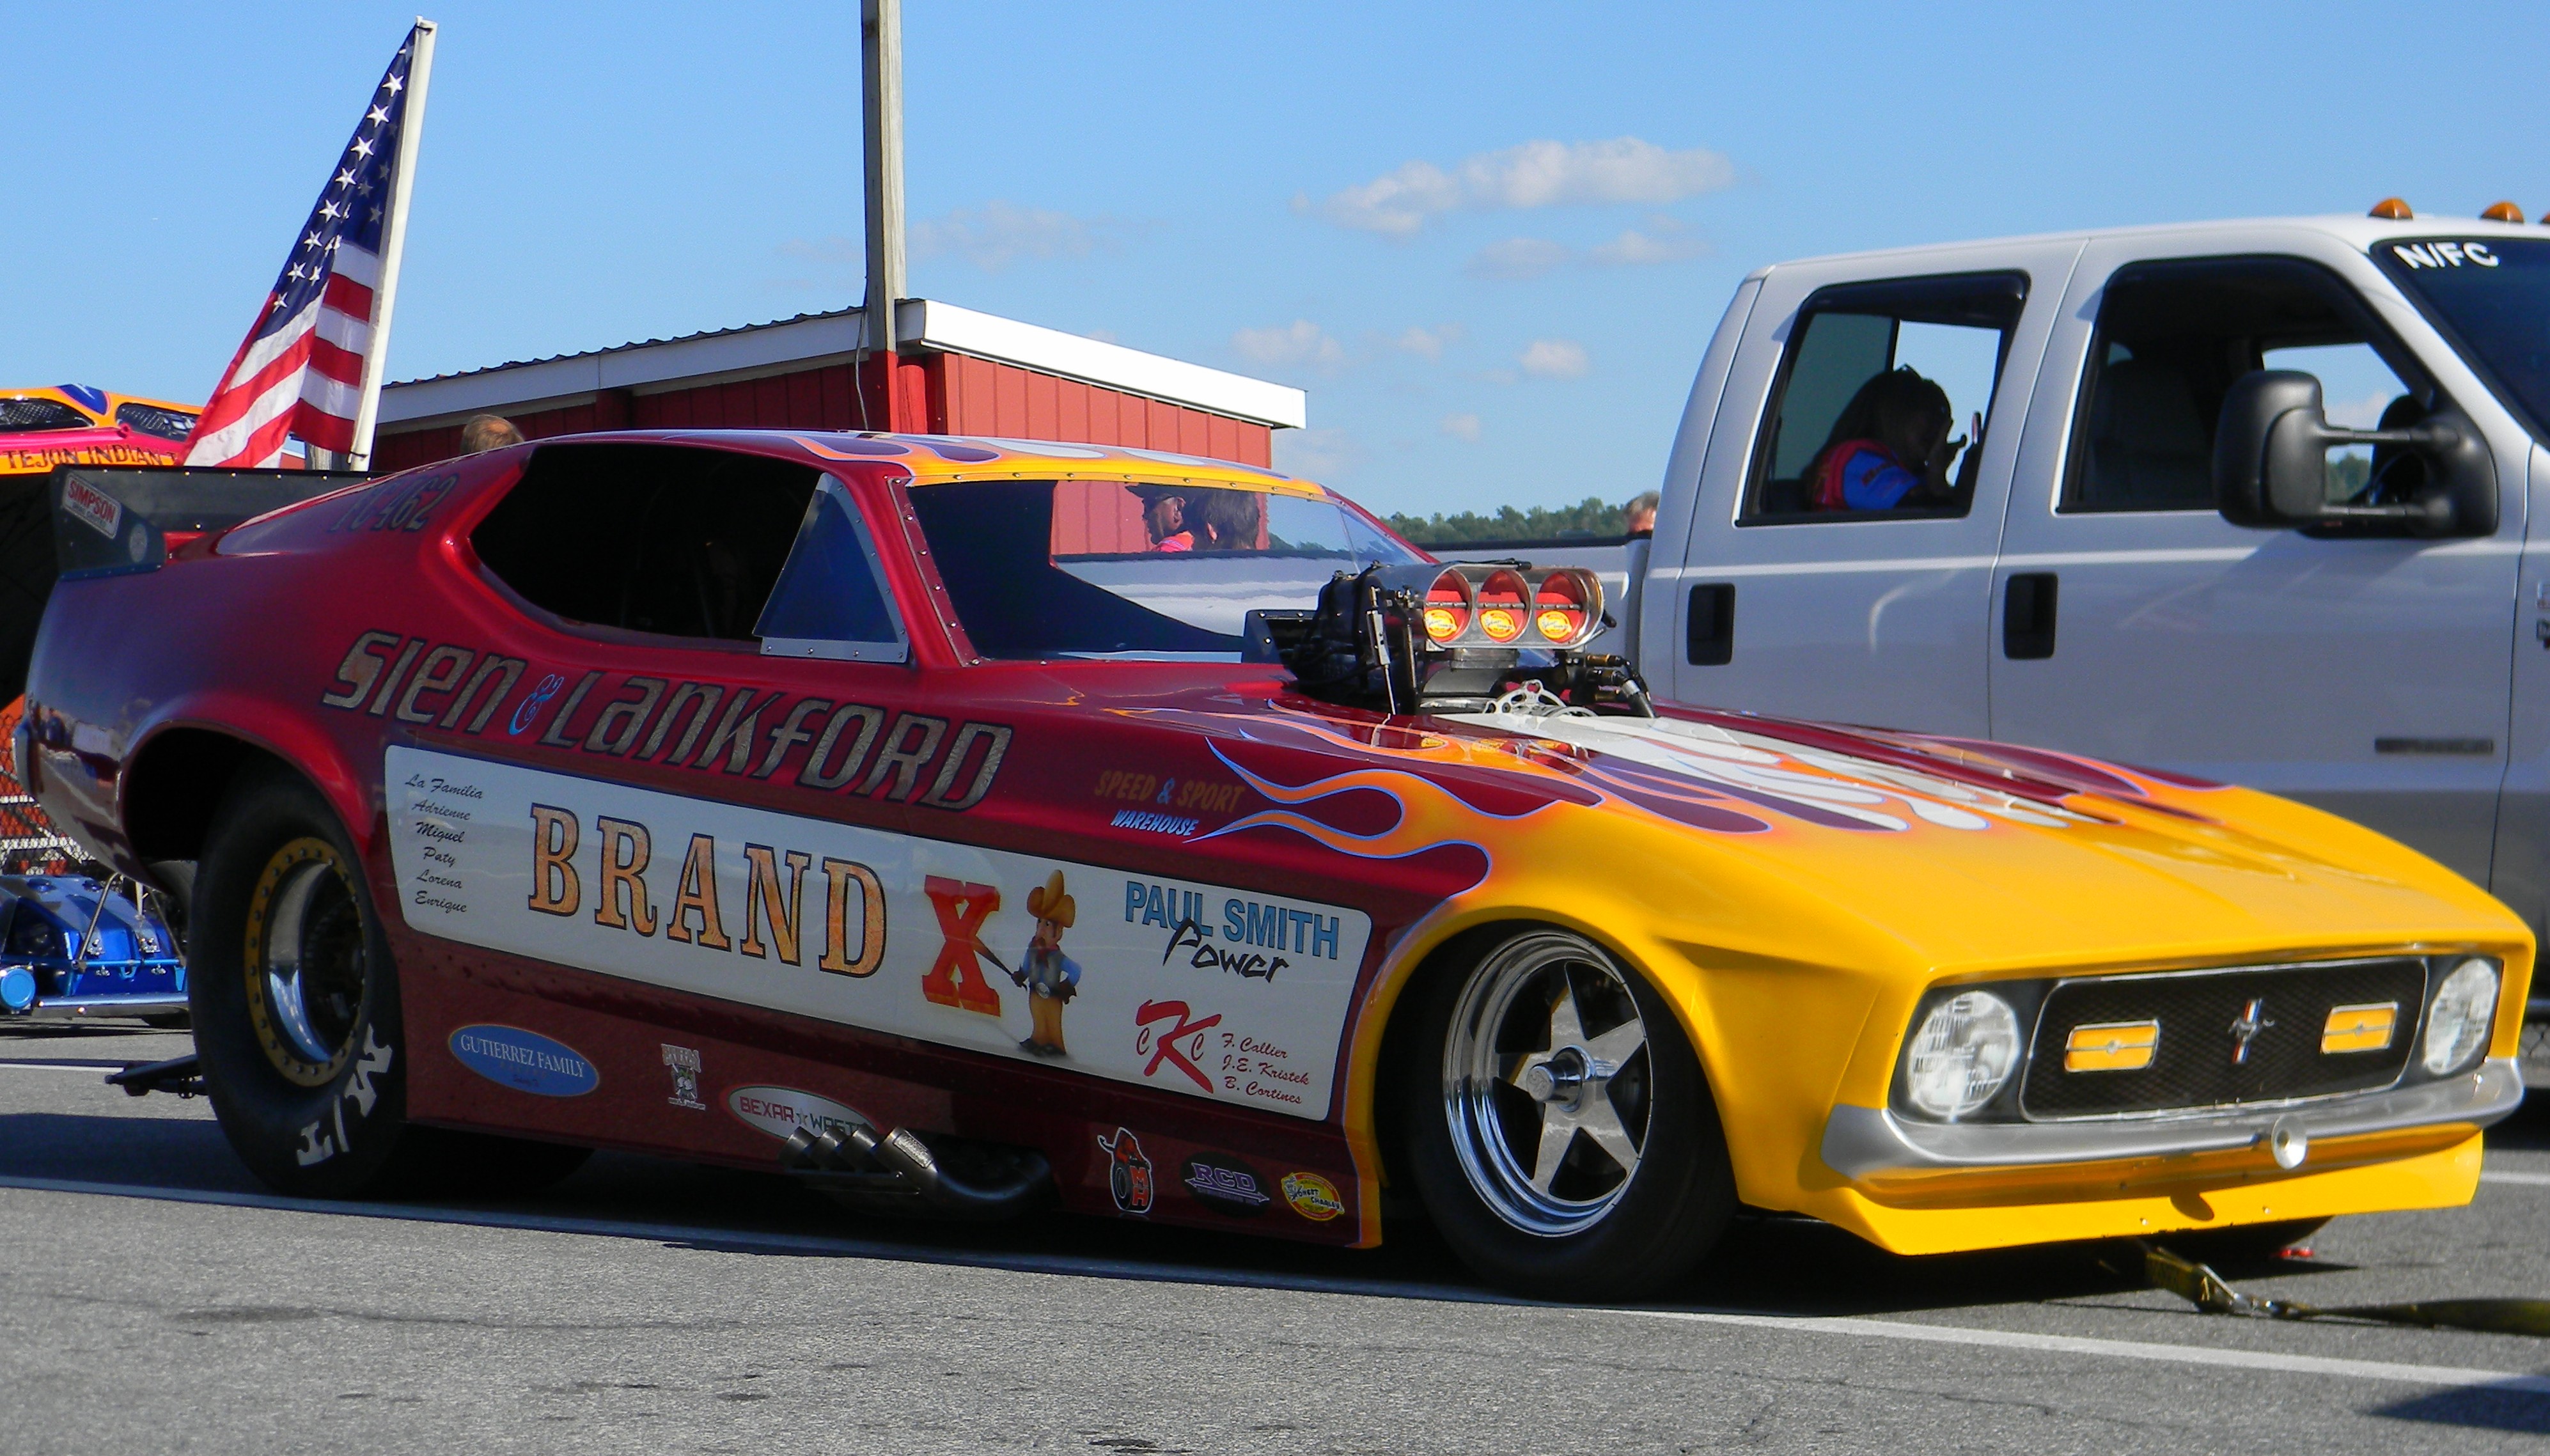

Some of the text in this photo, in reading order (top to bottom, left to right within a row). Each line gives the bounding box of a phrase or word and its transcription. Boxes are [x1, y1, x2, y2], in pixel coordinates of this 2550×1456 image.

[2393, 242, 2499, 269] N/FC
[3, 448, 79, 468] TEJON
[86, 444, 162, 466] INDIAN
[68, 480, 116, 523] SIMPSON
[405, 774, 483, 799] La Familia
[1094, 770, 1246, 813] SPEED & SPORT
[412, 799, 471, 820] Adrienne
[416, 821, 465, 843] Miguel
[1110, 810, 1199, 836] WAREHOUSE
[423, 846, 456, 868] Paty
[417, 869, 462, 889] Lorena
[415, 890, 467, 913] Enrique
[528, 802, 1001, 1018] BRAND X
[1125, 881, 1339, 960] PAUL SMITH
[1163, 916, 1289, 983] Power
[1221, 1033, 1235, 1048] F.
[460, 1034, 535, 1066] GUTIERREZ
[538, 1052, 584, 1078] FAMILY
[1258, 1062, 1309, 1085] Kristek
[1224, 1076, 1302, 1104] B. Cortines
[739, 1095, 864, 1136] BEXAR WAST
[1191, 1162, 1256, 1192] RCD
